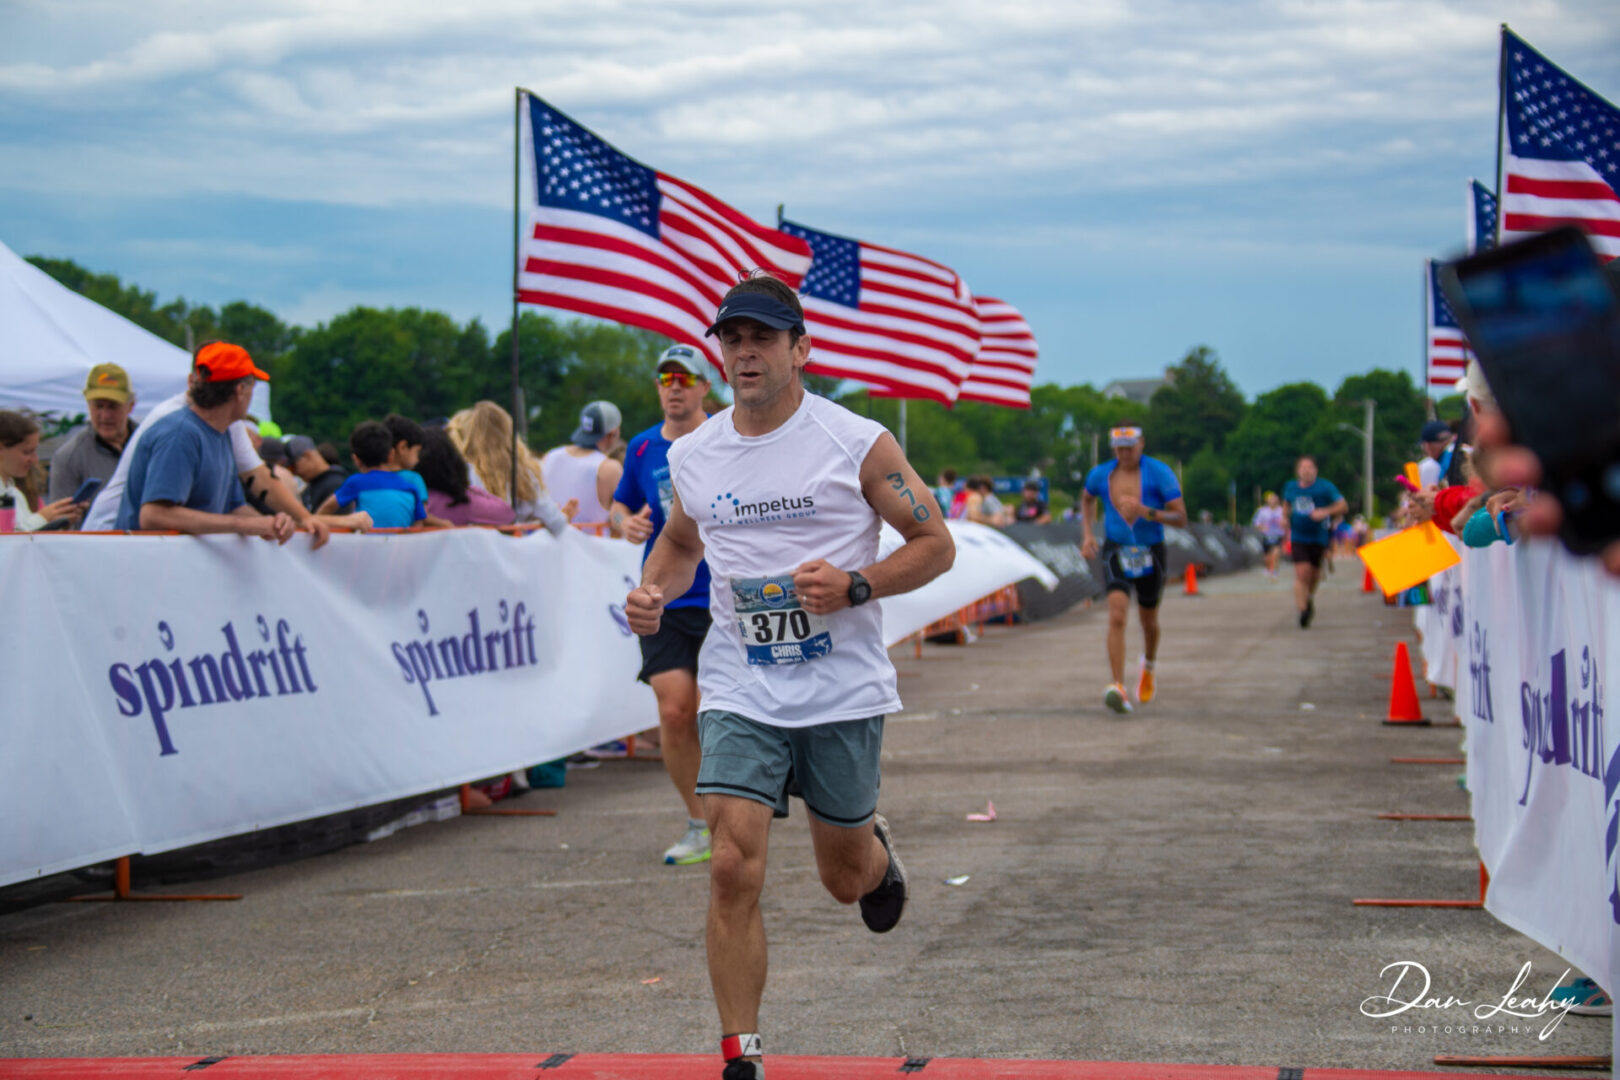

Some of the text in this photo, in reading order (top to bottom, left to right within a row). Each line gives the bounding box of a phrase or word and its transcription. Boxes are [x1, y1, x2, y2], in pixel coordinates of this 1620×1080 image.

[734, 495, 814, 517] impetus
[886, 471, 930, 523] 370
[737, 509, 817, 525] WELLNESS GROUP
[751, 609, 811, 644] 370
[391, 599, 539, 717] spindrift
[770, 644, 803, 659] CHRIS
[108, 613, 318, 757] spindrift
